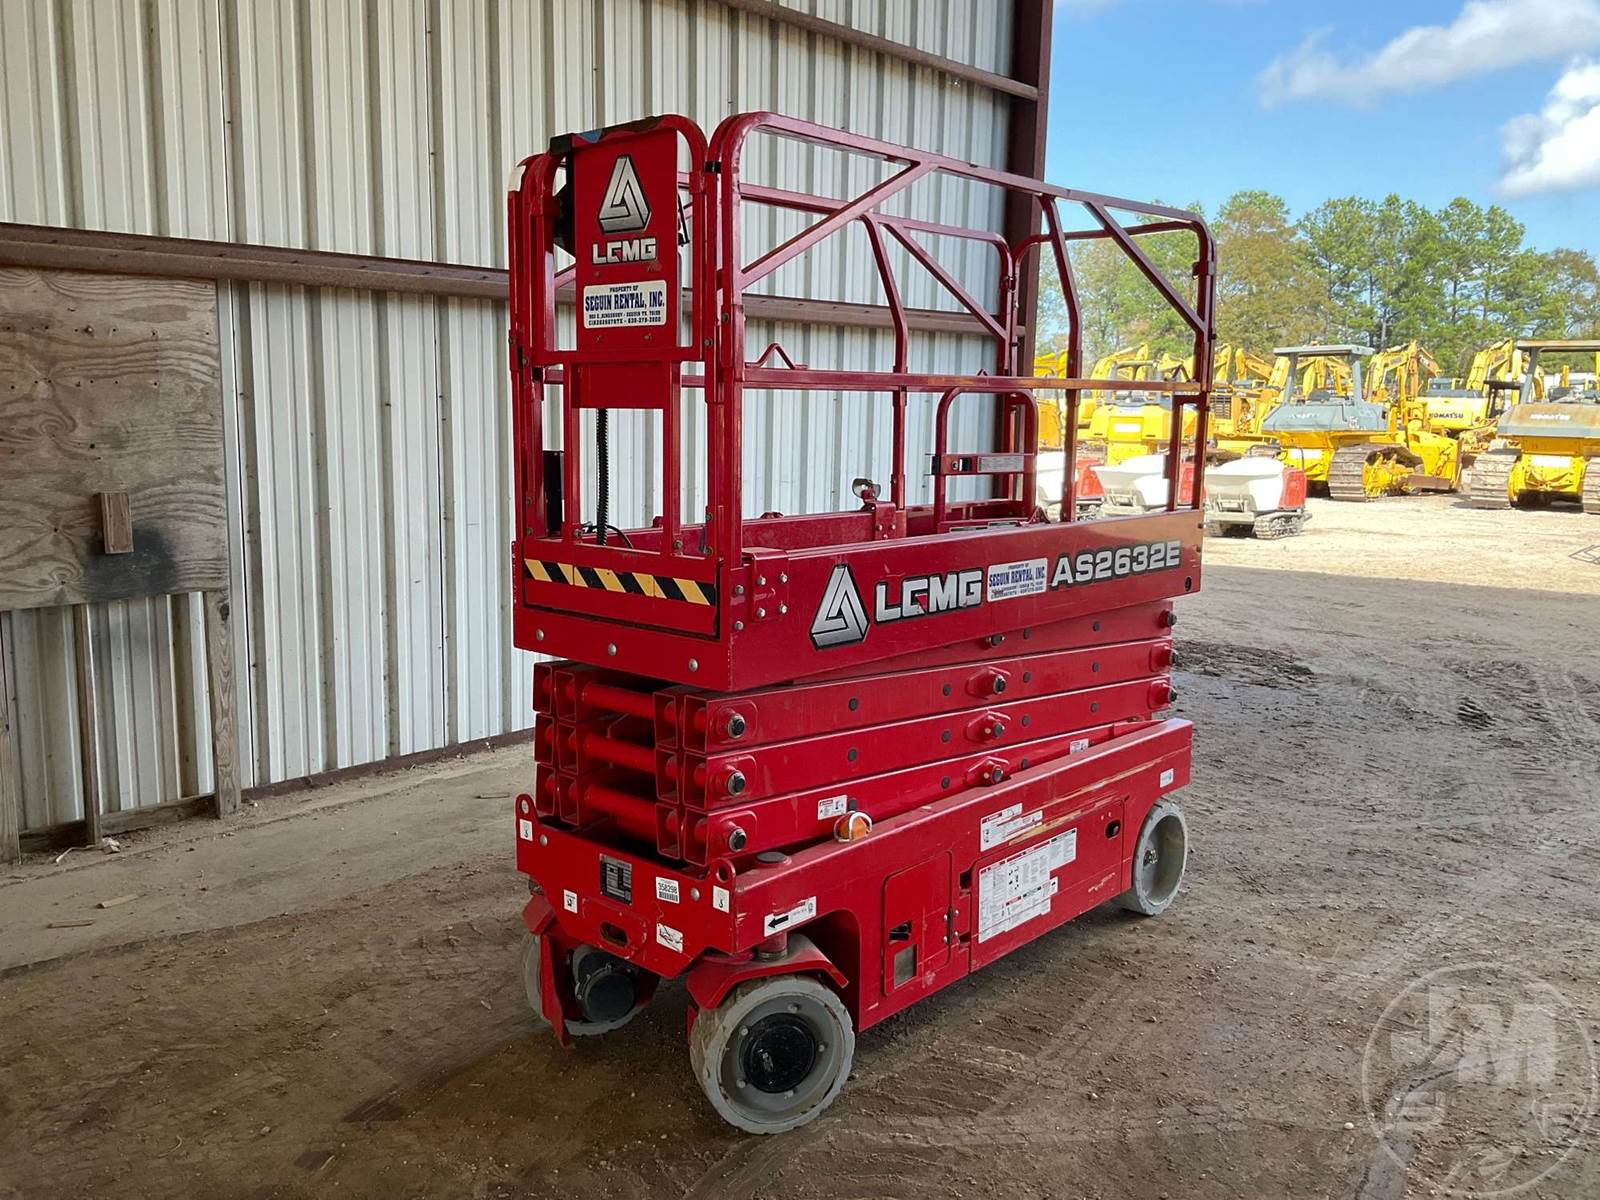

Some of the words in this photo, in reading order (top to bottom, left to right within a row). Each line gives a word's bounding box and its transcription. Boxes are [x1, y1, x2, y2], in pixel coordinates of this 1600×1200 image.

[585, 294, 612, 312] SEGUIN
[614, 291, 647, 309] RENTAL,
[649, 290, 665, 307] INC.
[1051, 541, 1180, 587] AS2632E
